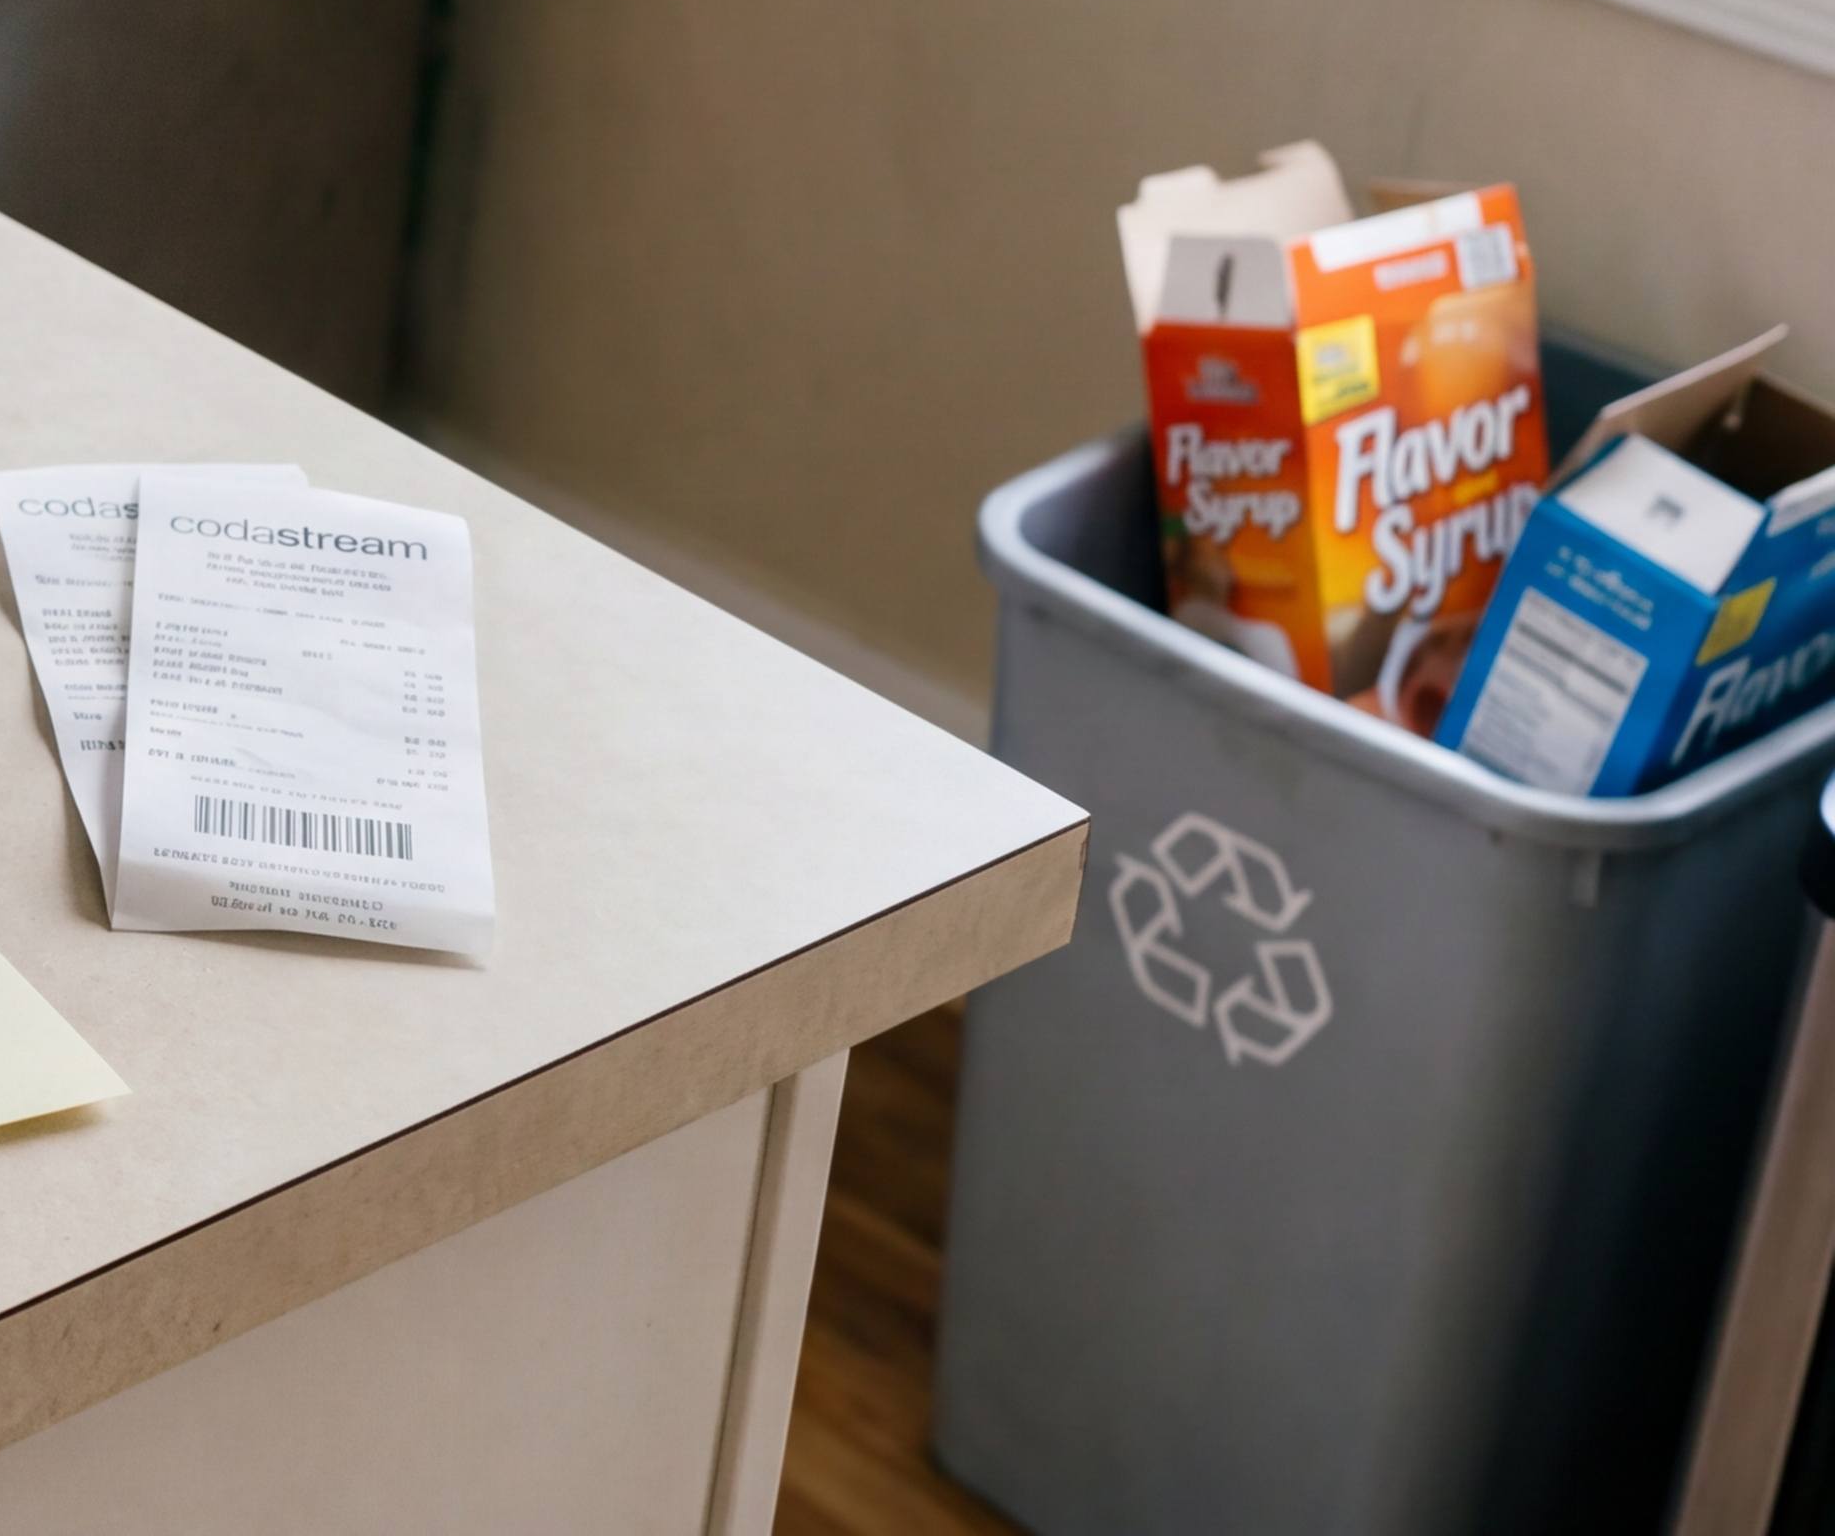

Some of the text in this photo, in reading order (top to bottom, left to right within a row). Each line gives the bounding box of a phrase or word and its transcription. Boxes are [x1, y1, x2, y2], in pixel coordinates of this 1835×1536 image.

[1165, 421, 1293, 486] Flavor
[1335, 383, 1530, 533] Flavor
[169, 515, 428, 560] codastream
[1183, 473, 1302, 544] Syrup
